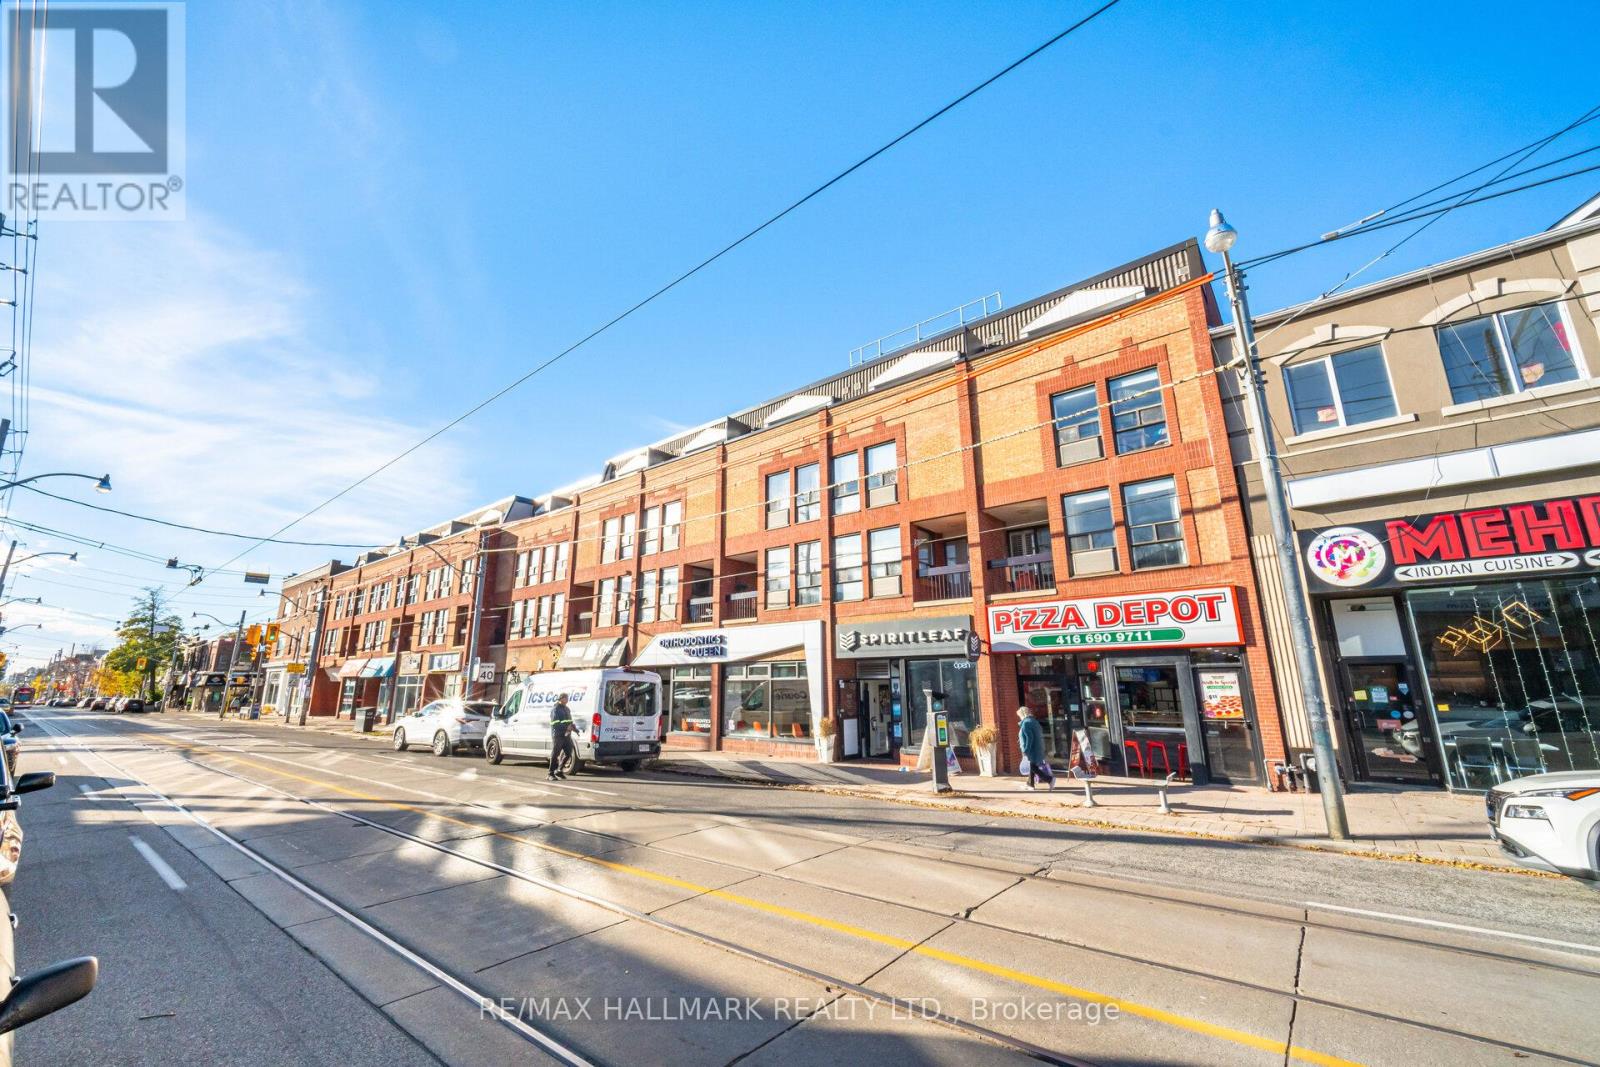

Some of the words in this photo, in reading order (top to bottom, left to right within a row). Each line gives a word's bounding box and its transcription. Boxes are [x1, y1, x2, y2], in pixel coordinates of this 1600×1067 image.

[1414, 563, 1473, 577] INDIAN
[1483, 556, 1554, 572] CUISINE
[1094, 592, 1226, 628] DEPOT
[659, 634, 721, 648] ORTHODONTICS
[860, 628, 963, 645] SPIRITLEAF
[1055, 635, 1081, 645] 416
[1085, 633, 1112, 643] 690
[1116, 631, 1152, 642] 9711
[690, 645, 721, 657] QUEEN
[480, 671, 494, 680] 40
[528, 691, 545, 704] ICS
